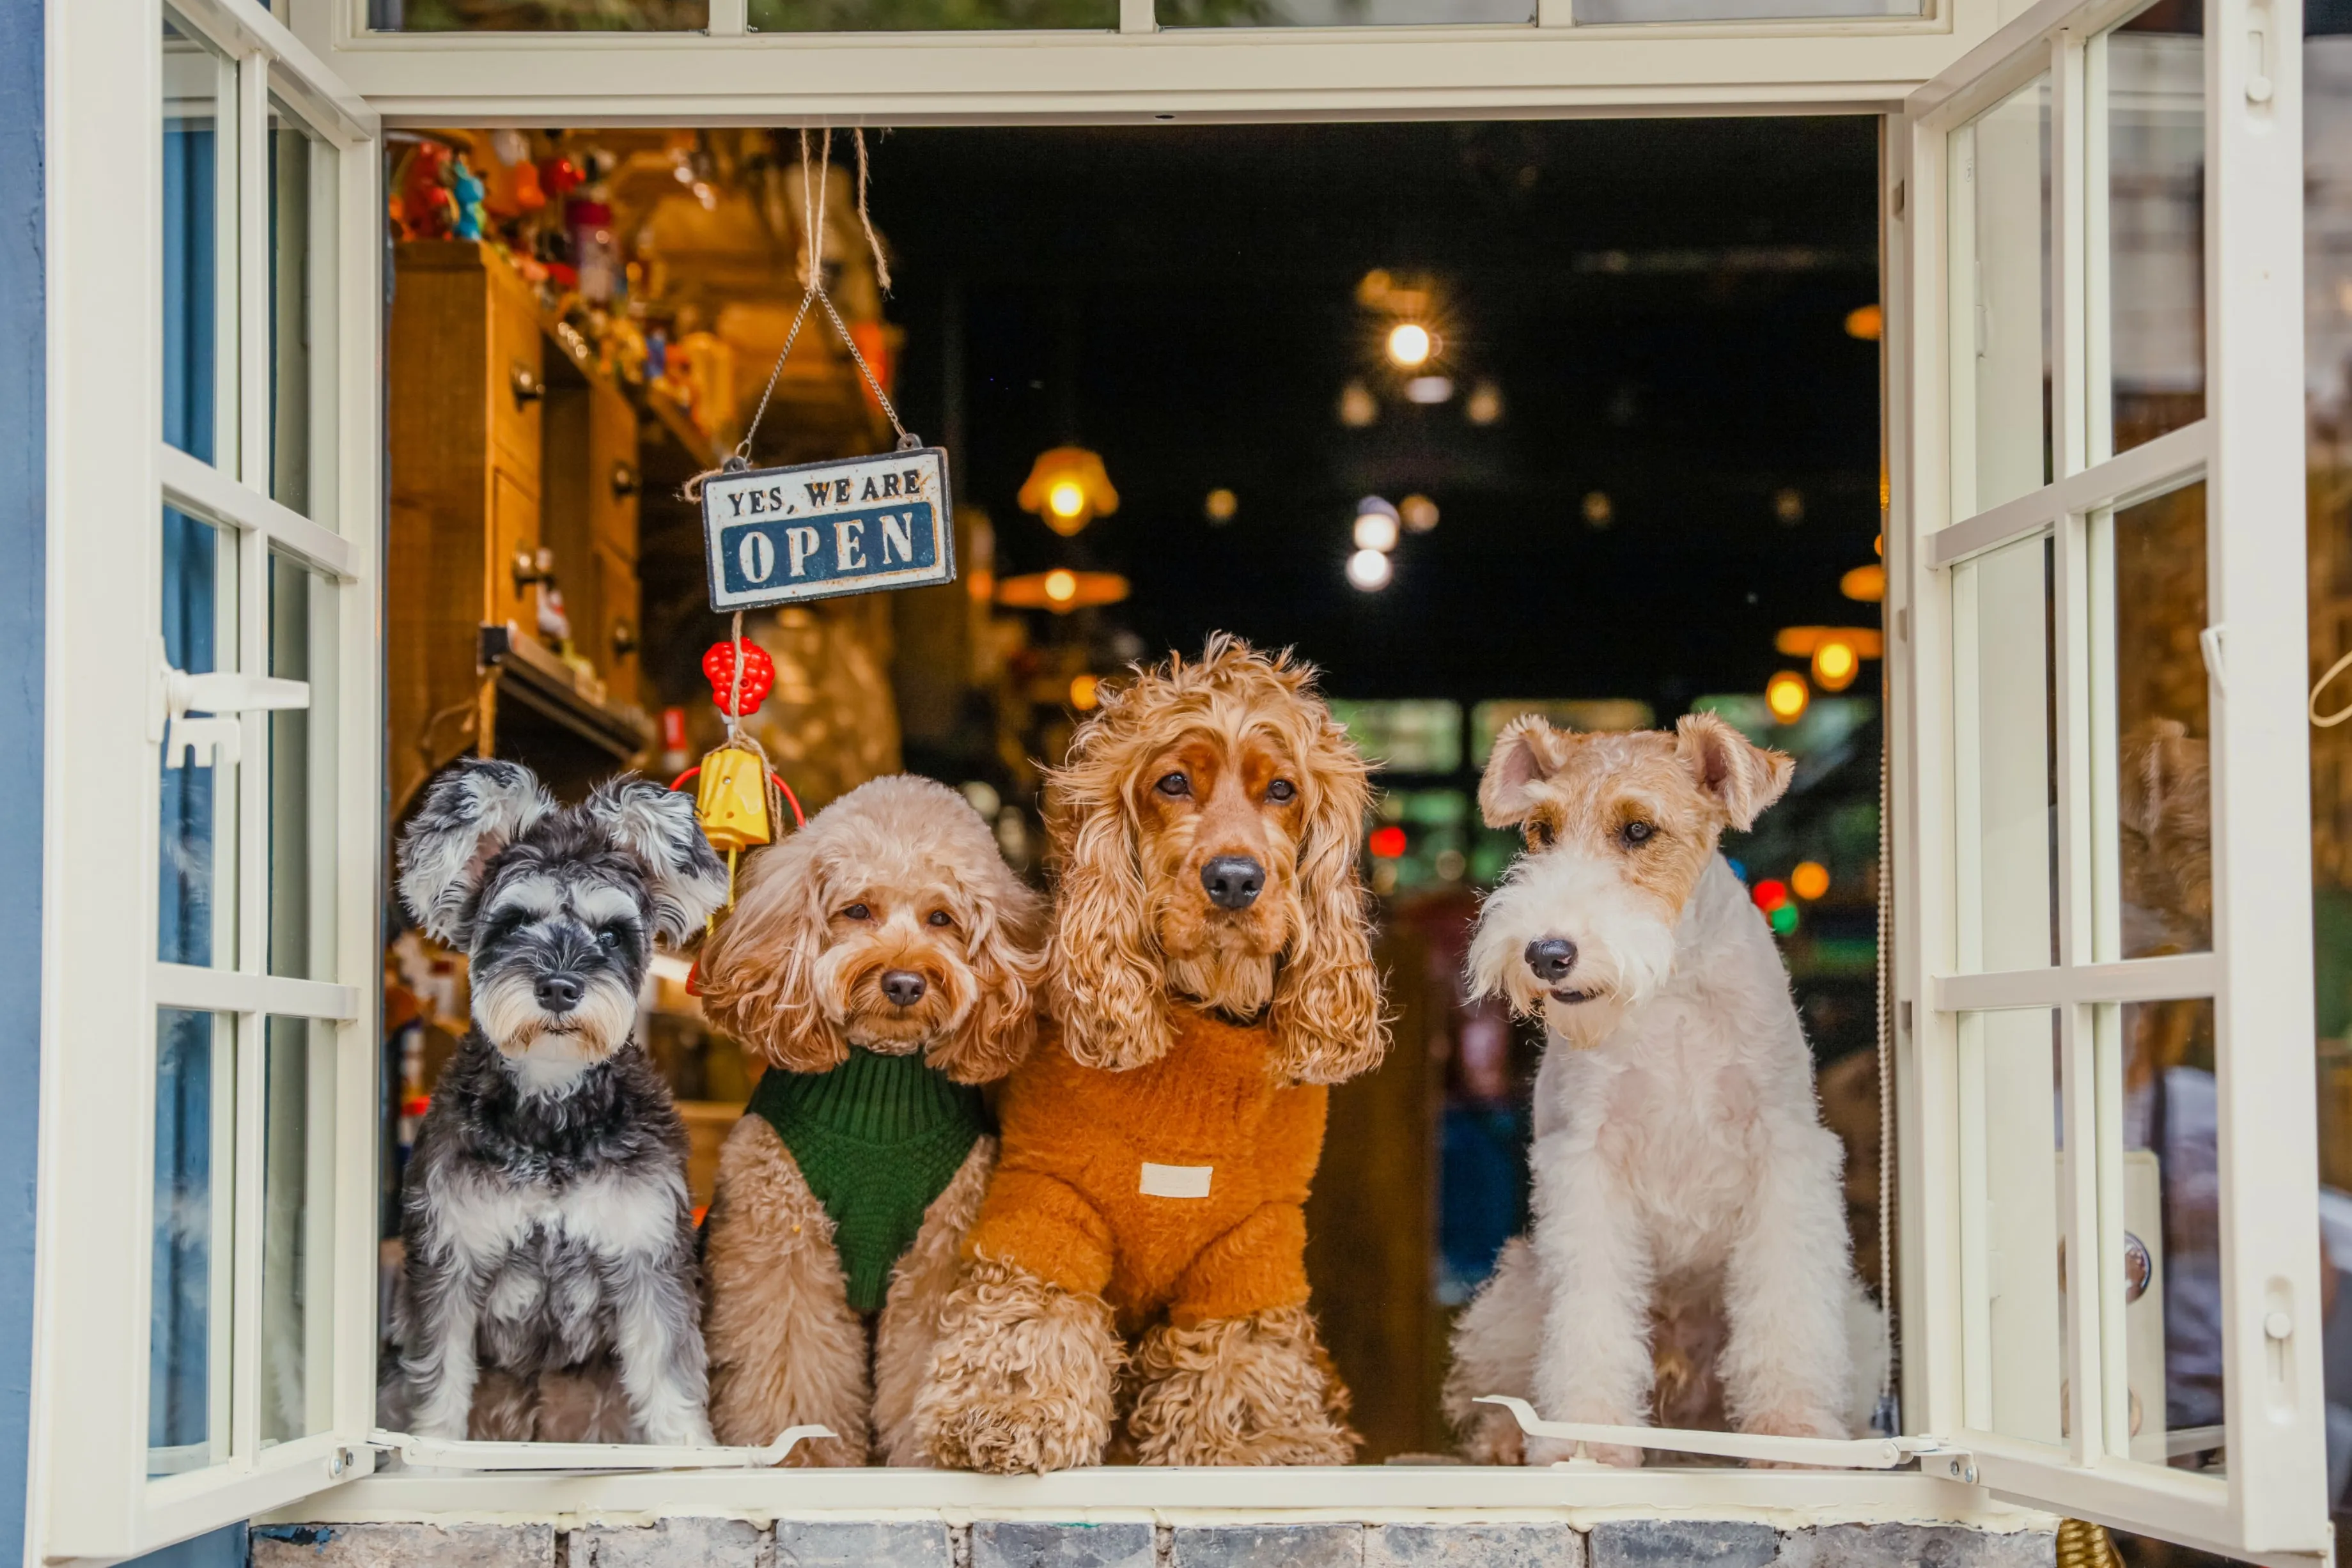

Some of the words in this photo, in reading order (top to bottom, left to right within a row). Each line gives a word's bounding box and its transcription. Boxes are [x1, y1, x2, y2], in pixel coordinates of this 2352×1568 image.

[728, 486, 795, 516] YES,
[804, 479, 851, 507] WE
[861, 470, 921, 501] ARE
[739, 512, 913, 583] OPEN
